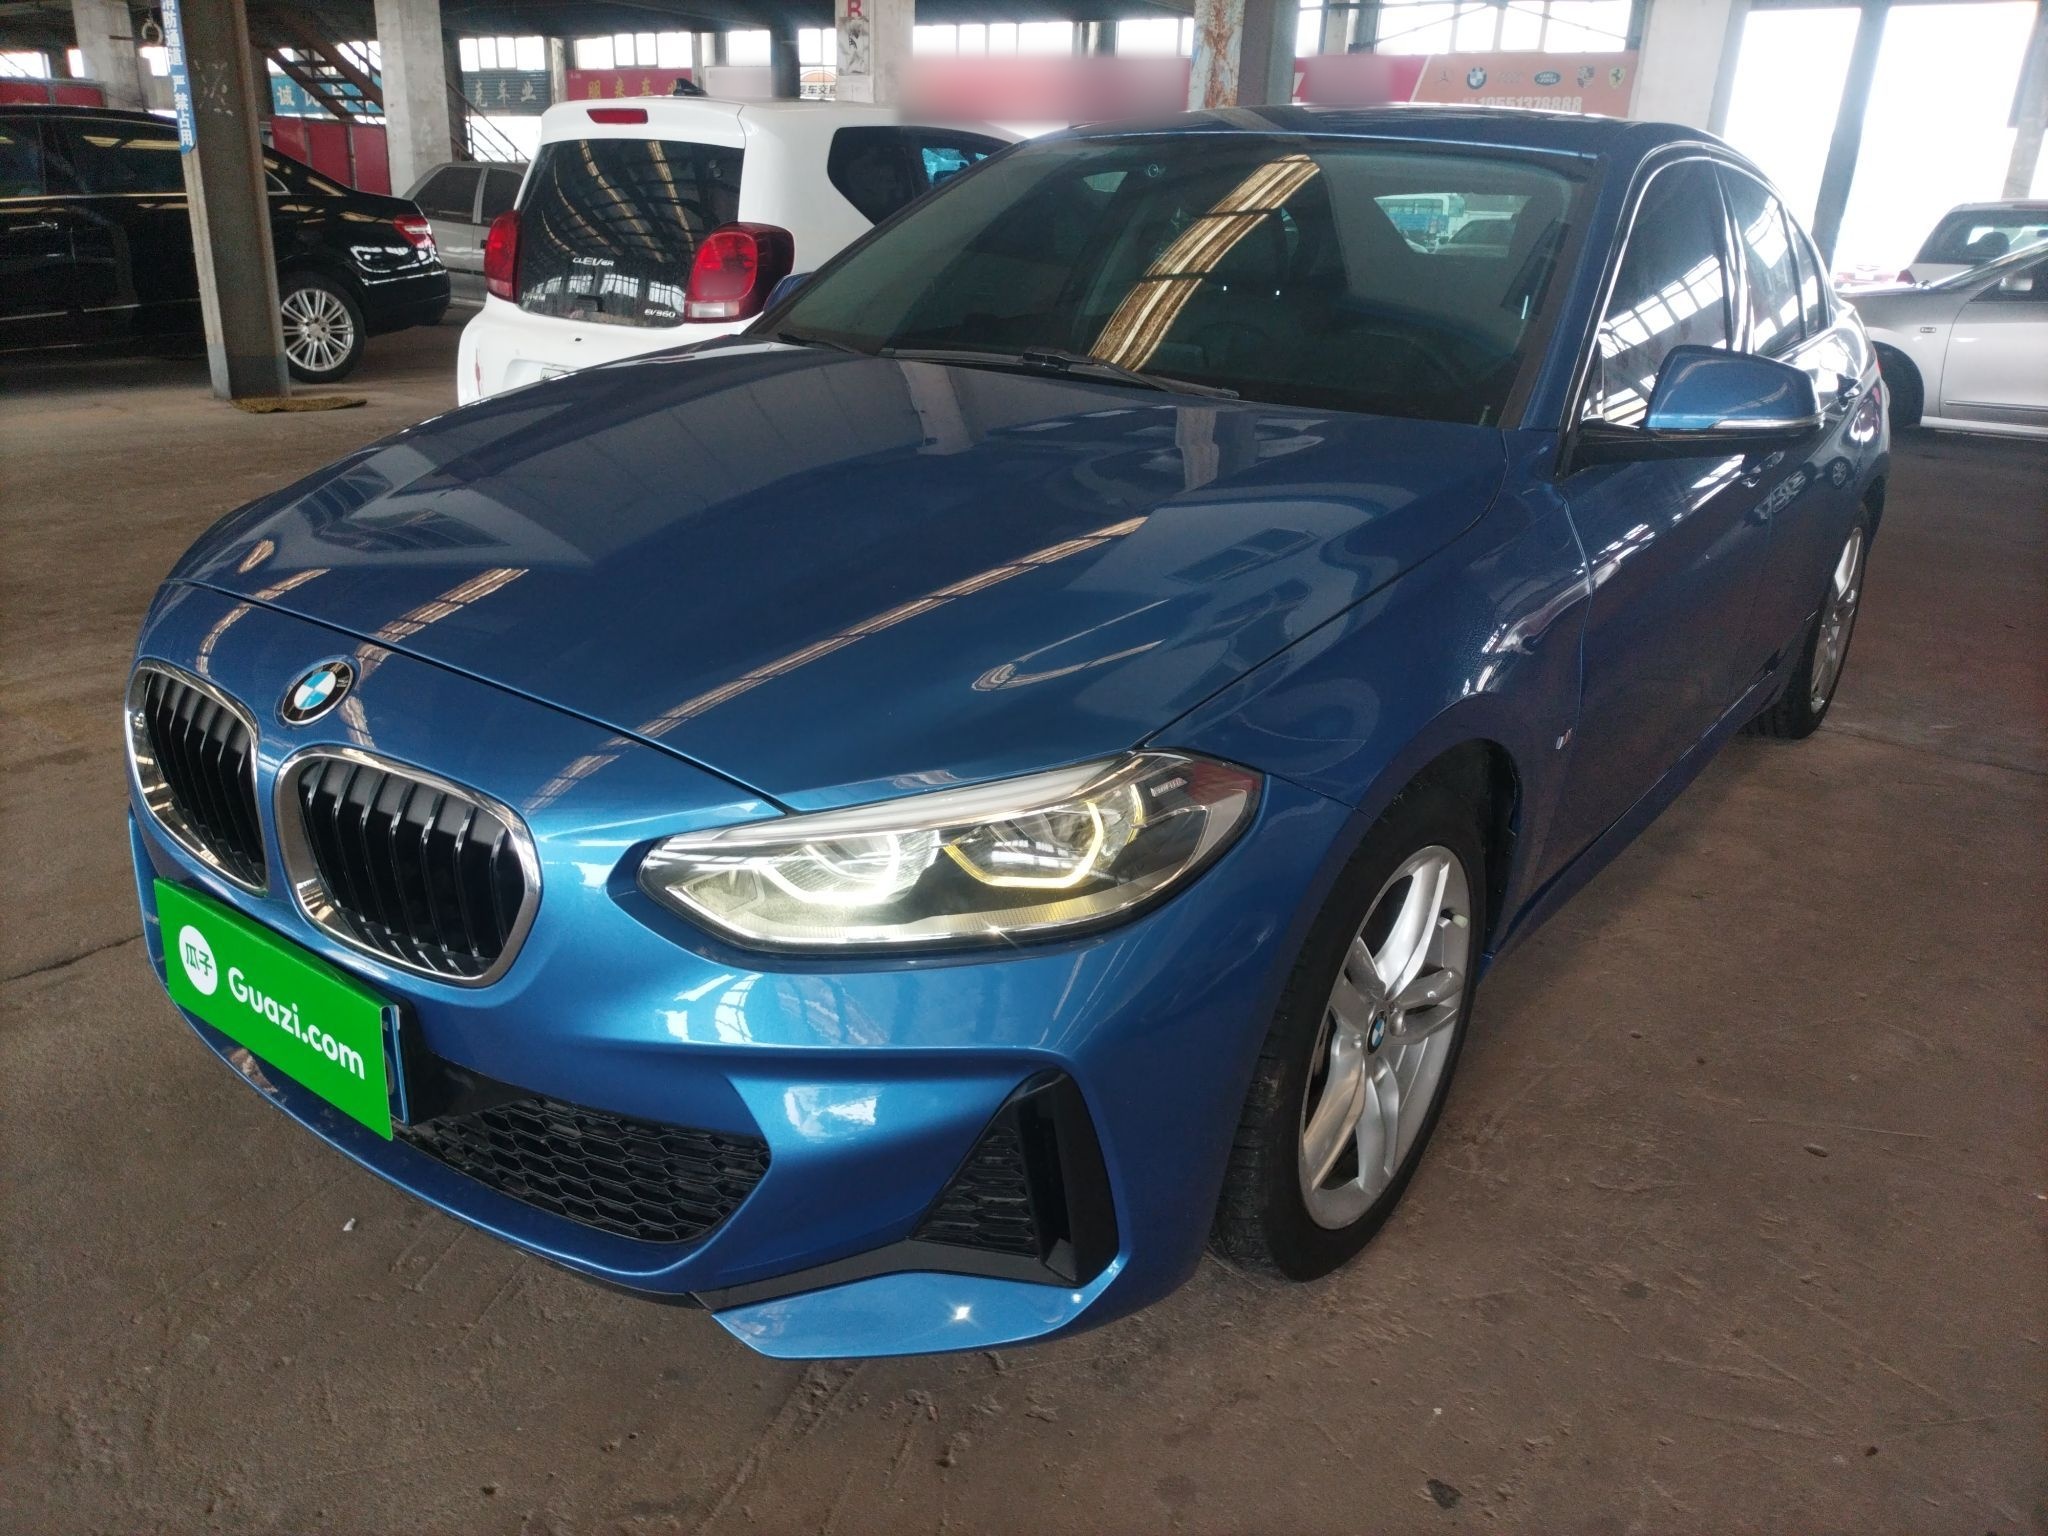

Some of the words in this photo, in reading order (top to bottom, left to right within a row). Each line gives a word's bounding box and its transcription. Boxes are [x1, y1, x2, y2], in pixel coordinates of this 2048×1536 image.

[162, 0, 183, 65] 消防通道
[172, 75, 193, 146] 严禁占用
[572, 256, 614, 267] CLEVER
[185, 942, 213, 976] 瓜子
[228, 966, 365, 1081] Guazi.com
